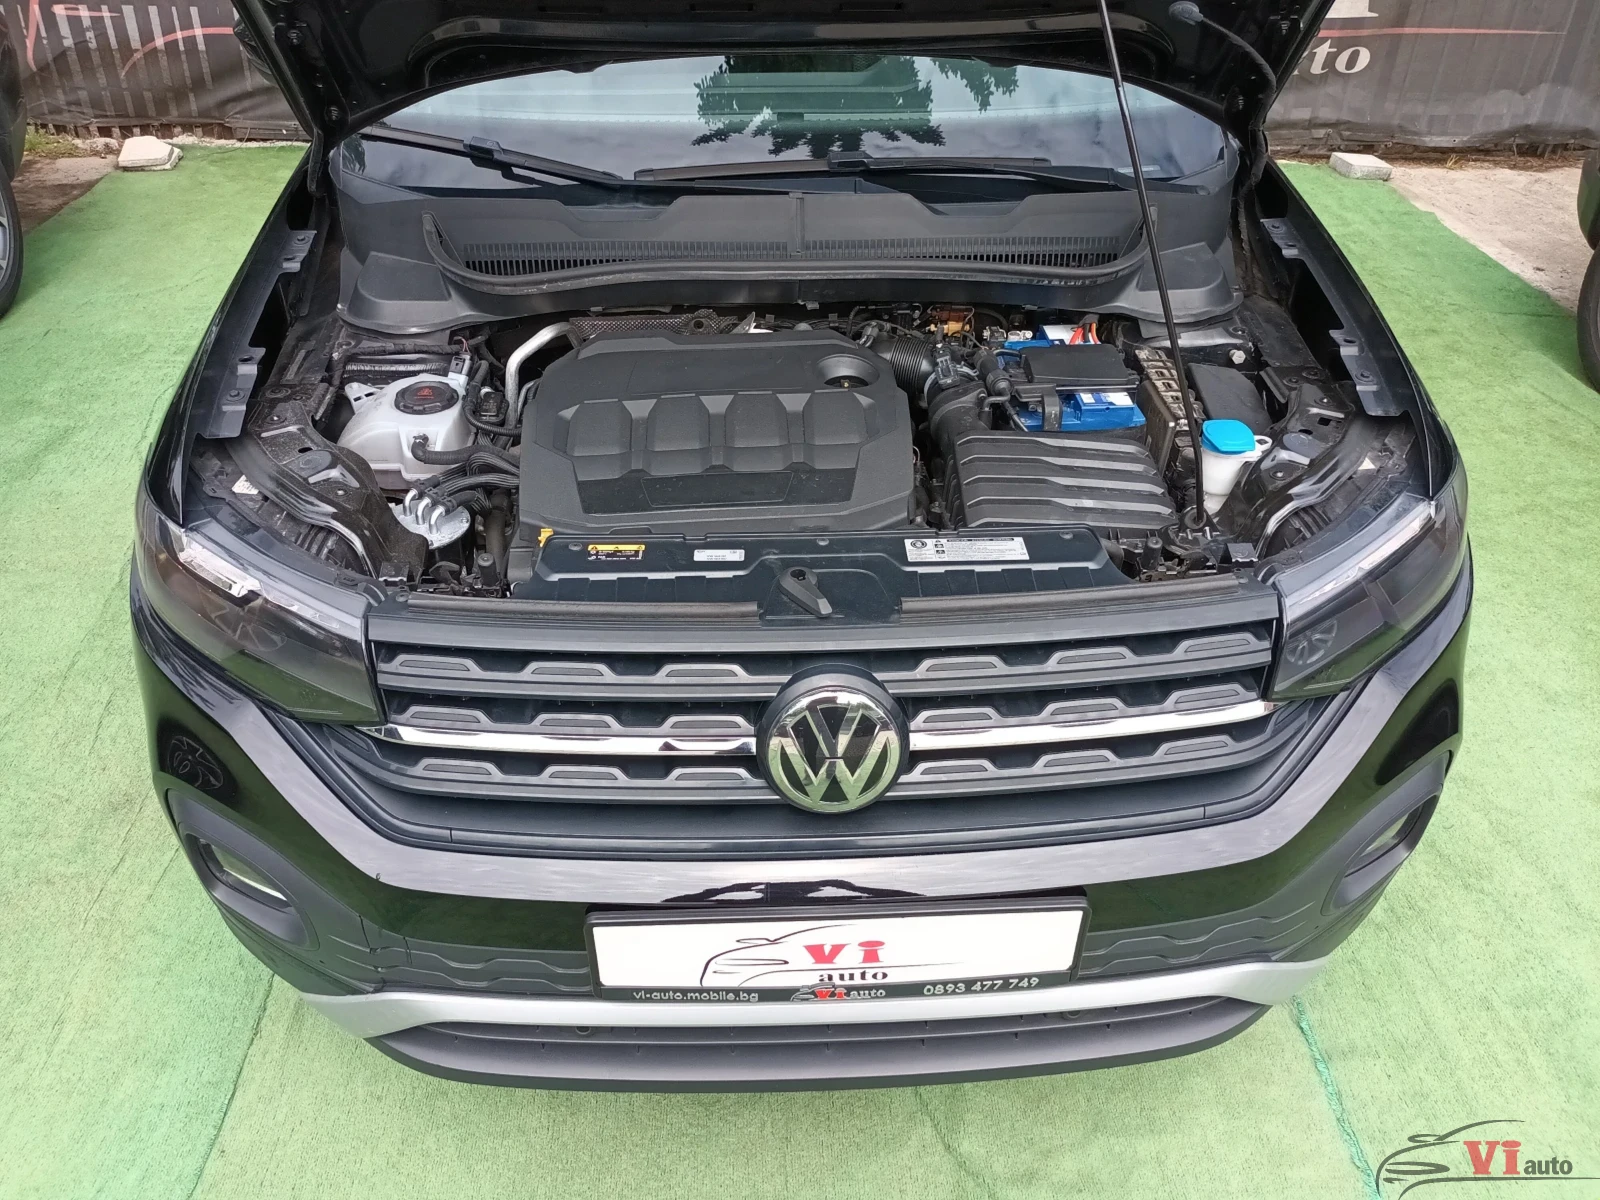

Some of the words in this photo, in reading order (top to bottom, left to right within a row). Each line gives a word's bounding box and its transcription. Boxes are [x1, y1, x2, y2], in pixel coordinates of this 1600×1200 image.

[1292, 39, 1371, 75] to
[818, 970, 888, 982] auto
[849, 988, 886, 999] auto
[923, 983, 966, 996] 0893
[971, 980, 1003, 992] 477
[1008, 977, 1040, 989] 749
